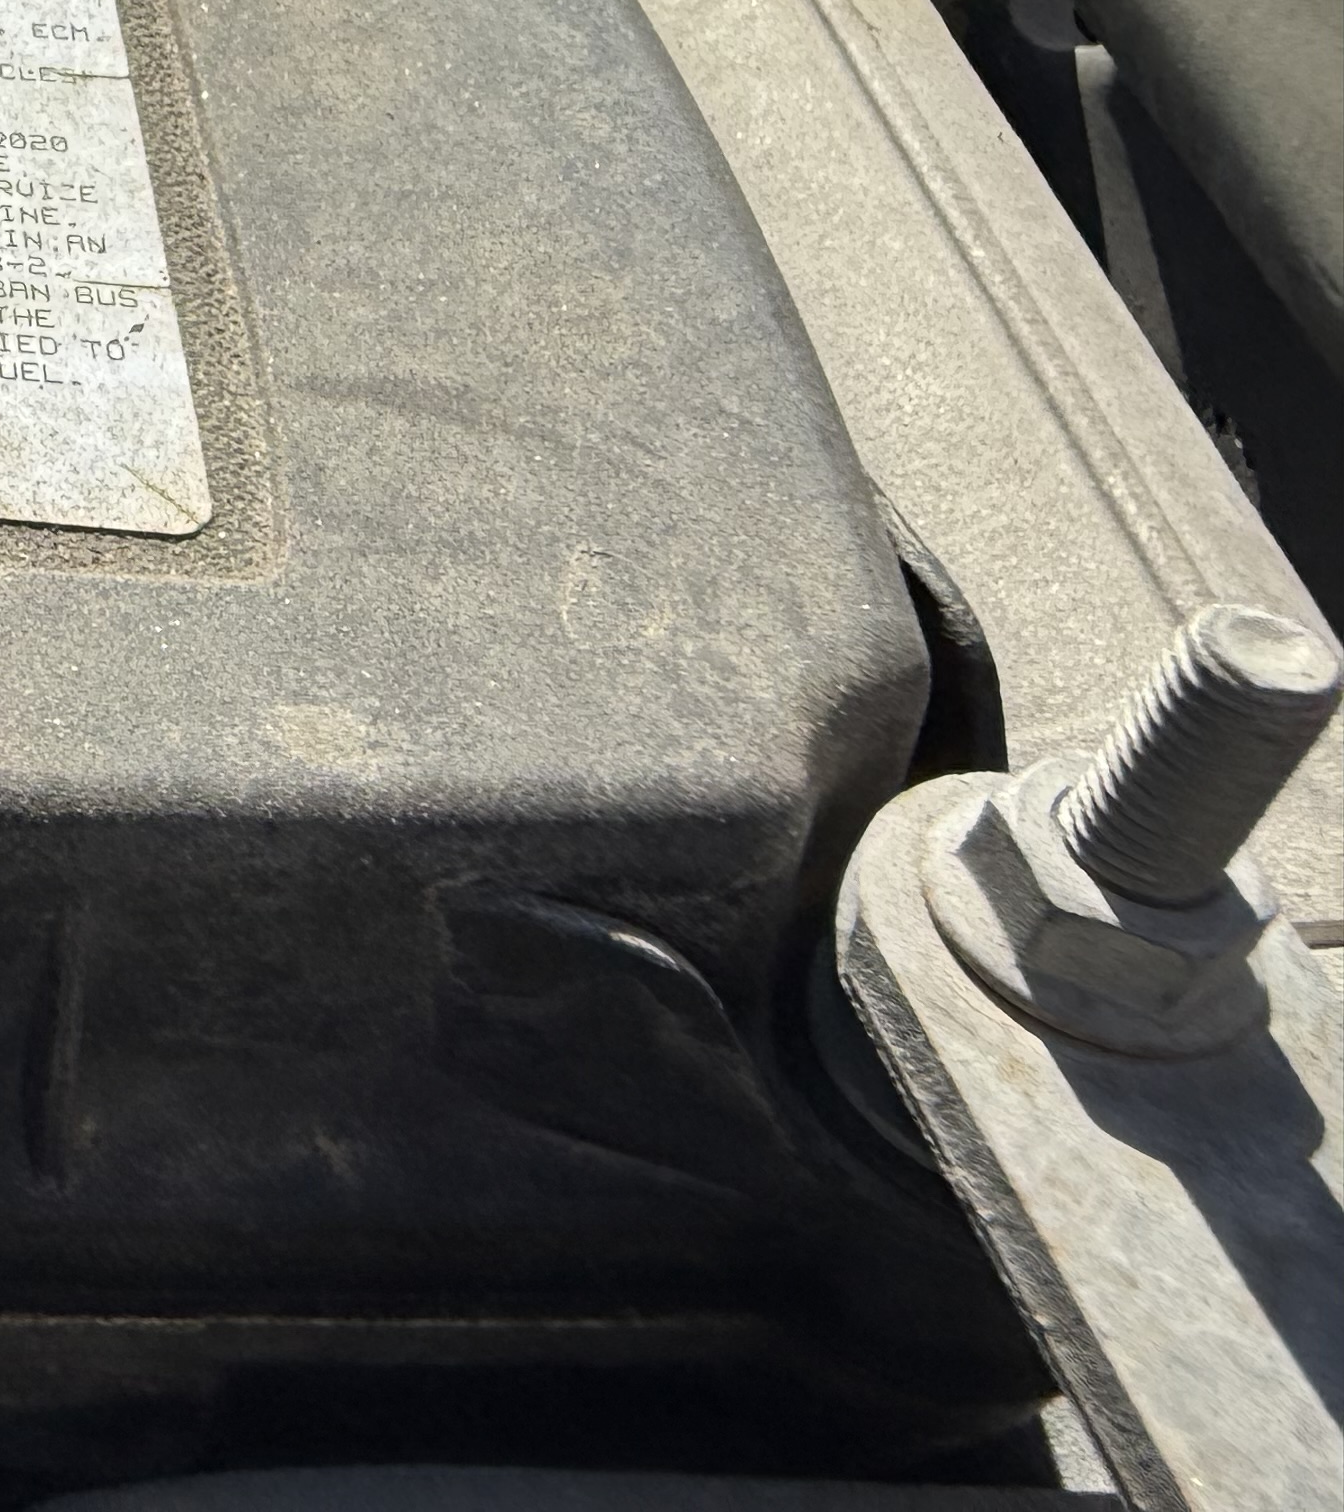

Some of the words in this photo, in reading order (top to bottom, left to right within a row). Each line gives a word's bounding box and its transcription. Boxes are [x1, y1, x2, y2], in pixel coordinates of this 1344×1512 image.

[5, 229, 43, 251] IN
[66, 232, 108, 254] AN
[74, 285, 138, 308] BUS
[80, 338, 125, 361] TO
